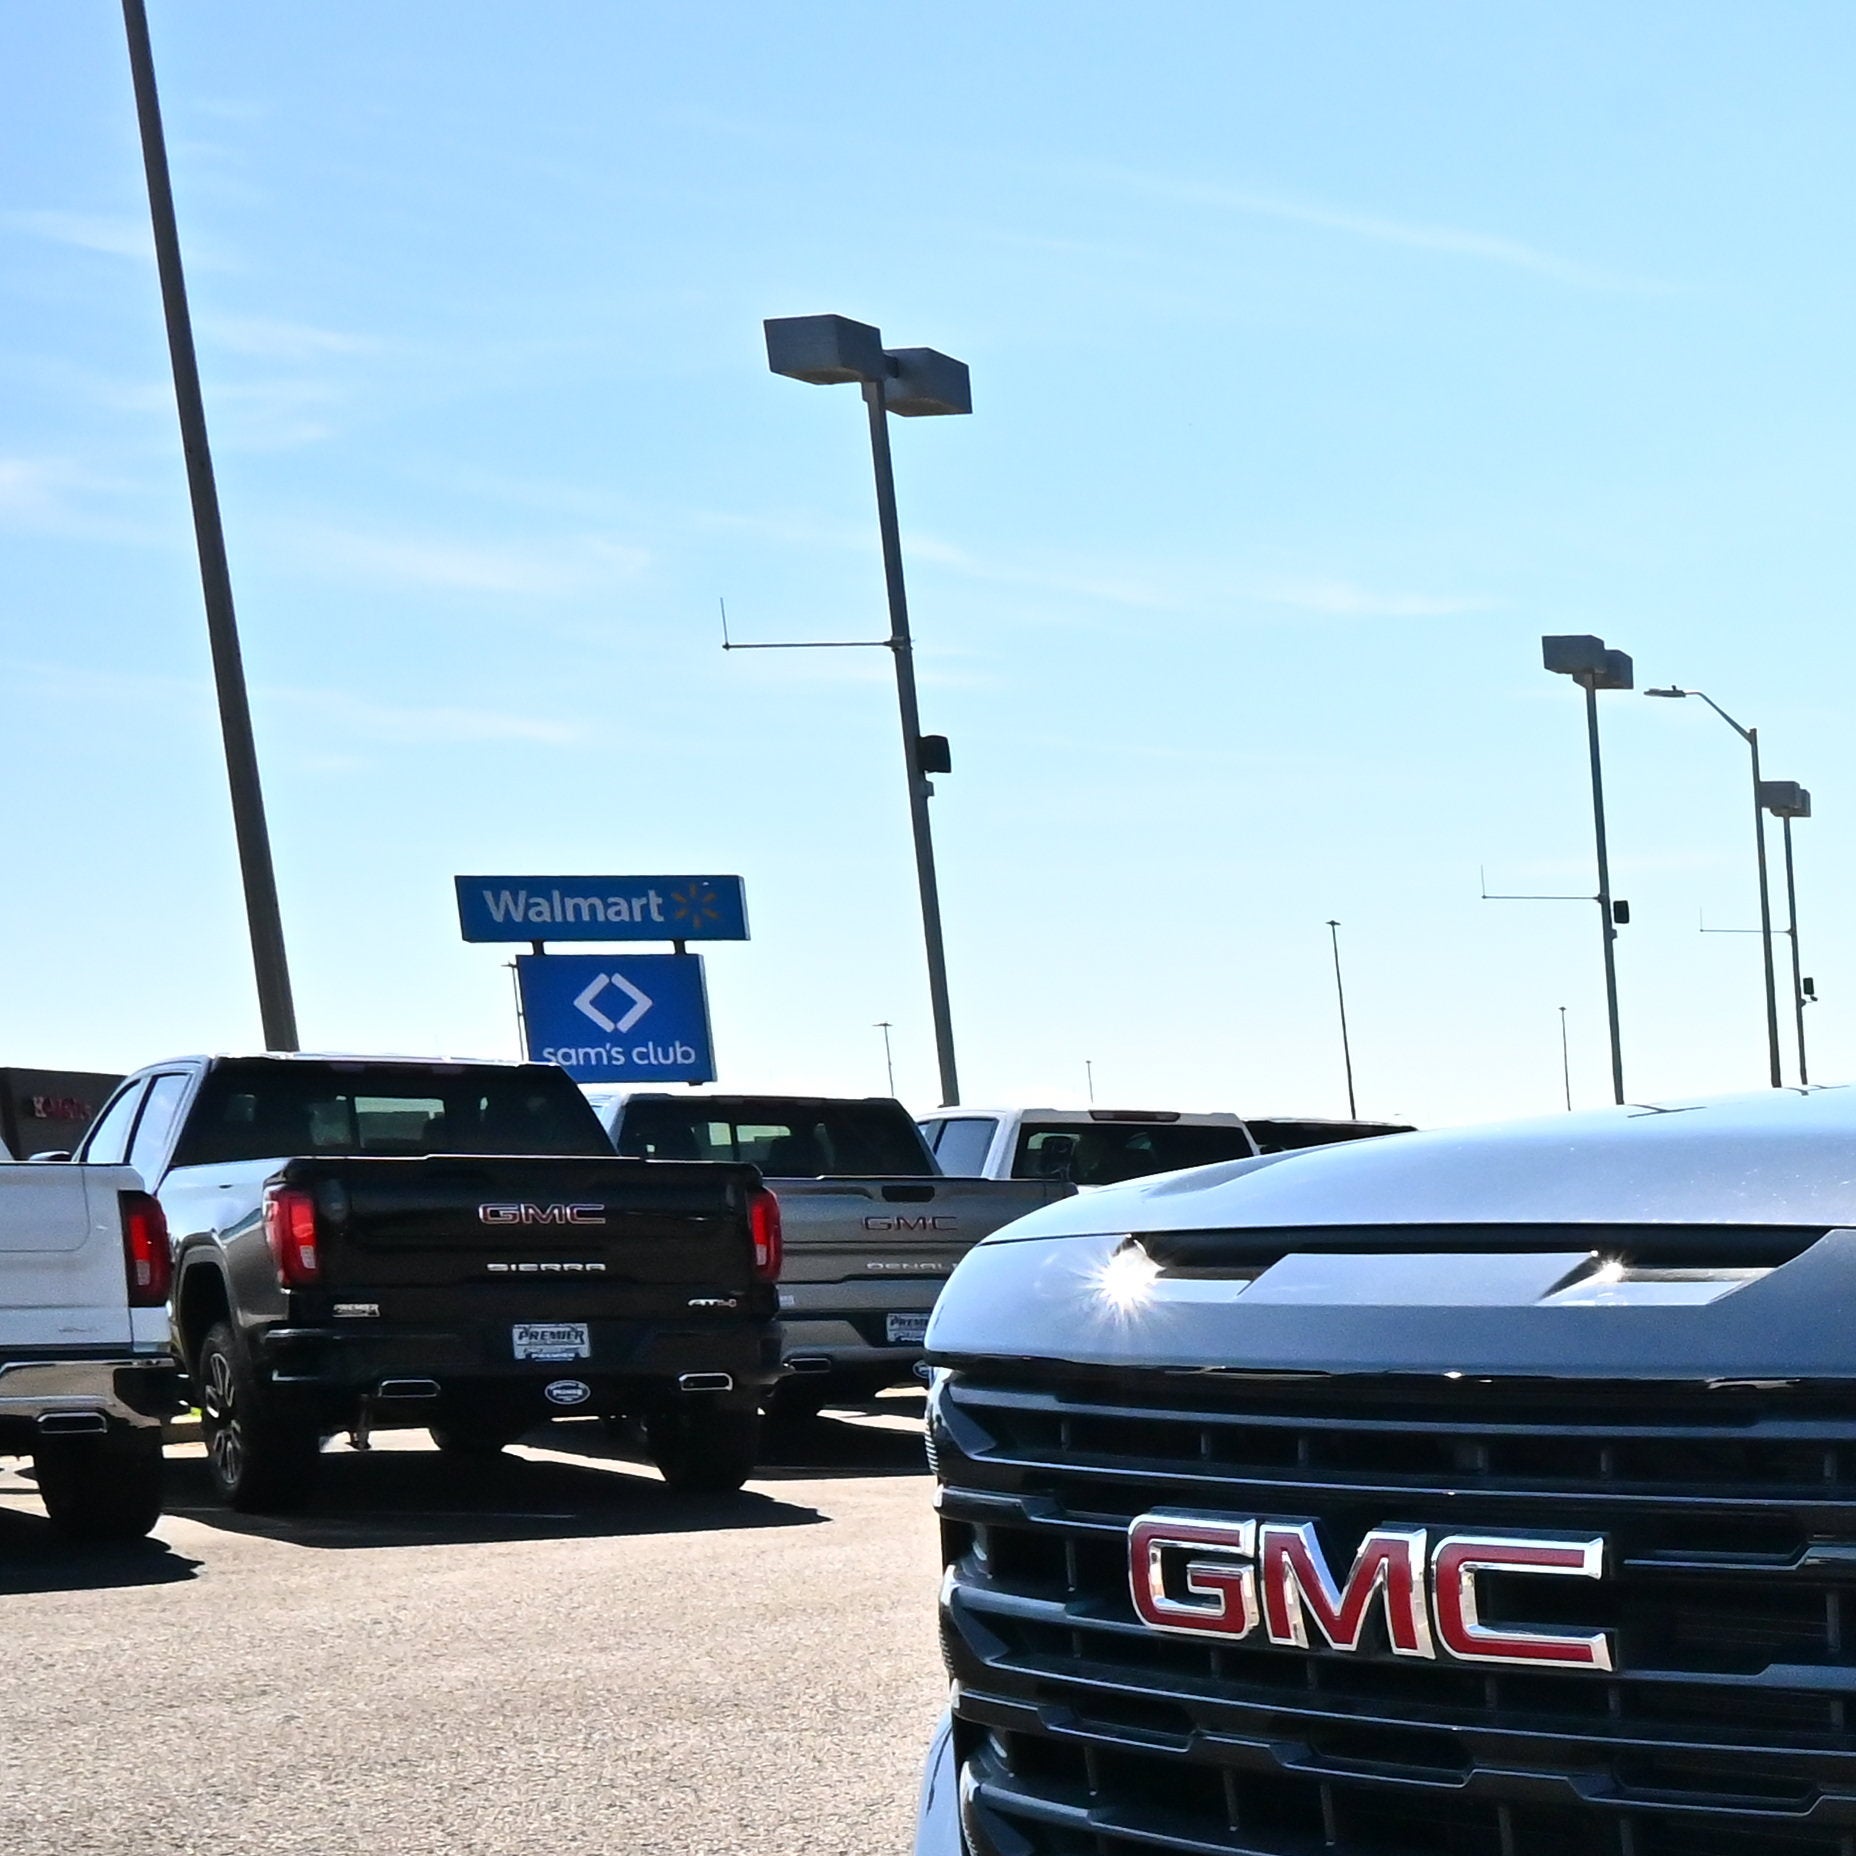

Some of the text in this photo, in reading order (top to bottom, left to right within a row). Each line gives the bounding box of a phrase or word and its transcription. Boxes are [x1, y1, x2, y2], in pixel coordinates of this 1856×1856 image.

[482, 889, 665, 923] Walmart
[542, 1040, 696, 1066] sam's club
[478, 1203, 606, 1225] GMC
[864, 1216, 959, 1231] GMC
[487, 1263, 606, 1272] SIERRA
[517, 1329, 585, 1345] PREMIER
[1128, 1512, 1614, 1673] GMC
